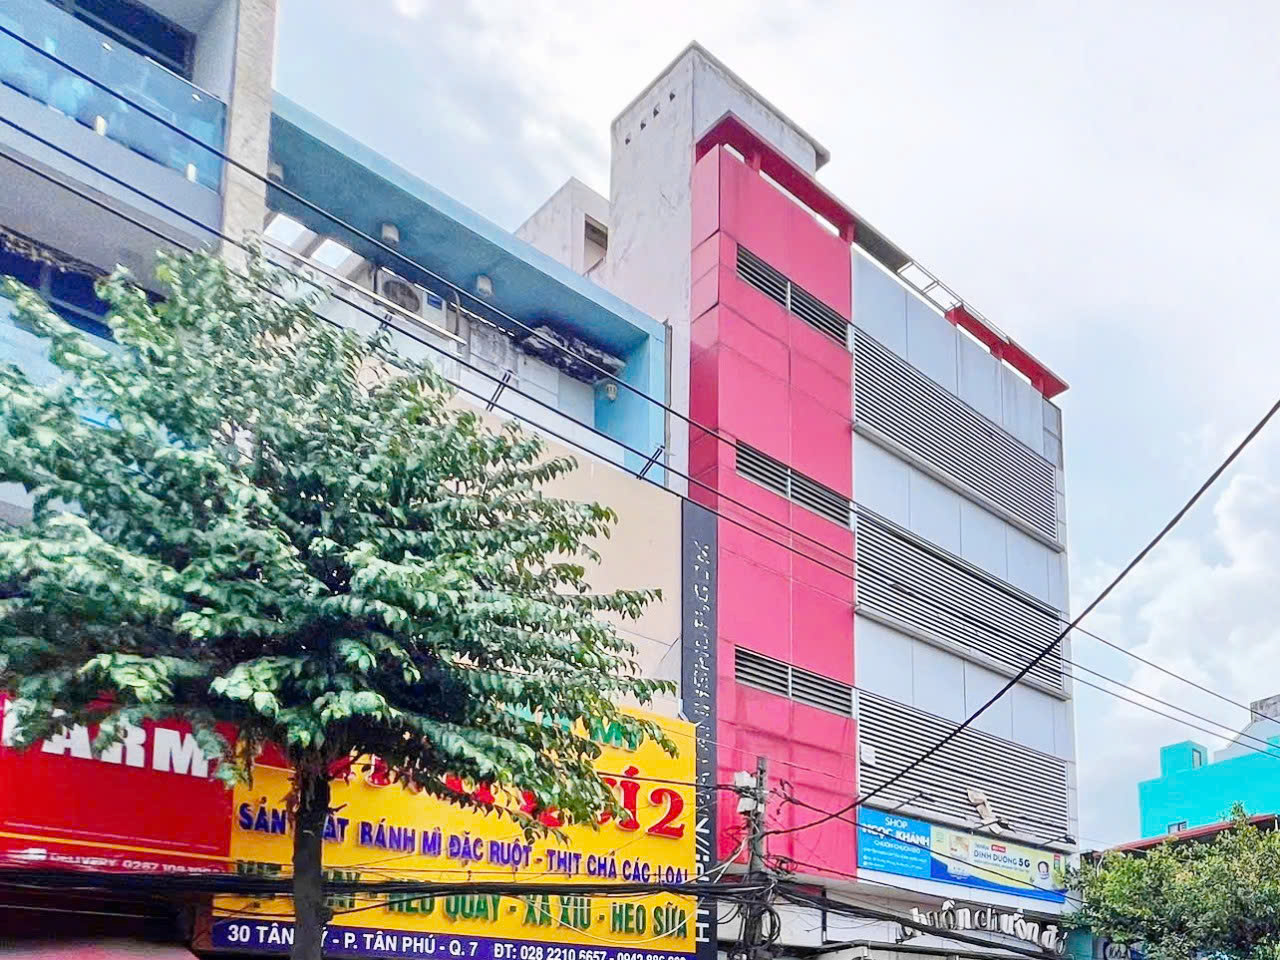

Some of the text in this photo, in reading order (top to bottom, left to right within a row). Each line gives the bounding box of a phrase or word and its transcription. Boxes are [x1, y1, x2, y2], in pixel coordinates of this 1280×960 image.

[3, 697, 209, 778] ARM
[885, 816, 908, 829] SHOP
[238, 796, 287, 835] SẢN
[358, 818, 417, 853] BÁNH
[421, 827, 442, 857] MÌ
[447, 831, 484, 867] ĐẶC
[547, 849, 582, 878] THỊT
[587, 850, 617, 879] CHẢ
[895, 829, 930, 848] KHÁNH
[1018, 858, 1030, 868] 5G
[611, 902, 647, 935] HEO
[653, 901, 688, 938] SỮA
[228, 924, 250, 942] 30
[256, 923, 295, 945] TÂN
[344, 932, 358, 950] P.
[363, 930, 398, 952] TÂN
[402, 934, 435, 954] PHÚ
[449, 940, 465, 957] Q.
[469, 942, 478, 957] 7
[494, 943, 517, 960] ĐT:
[520, 945, 543, 960] 028
